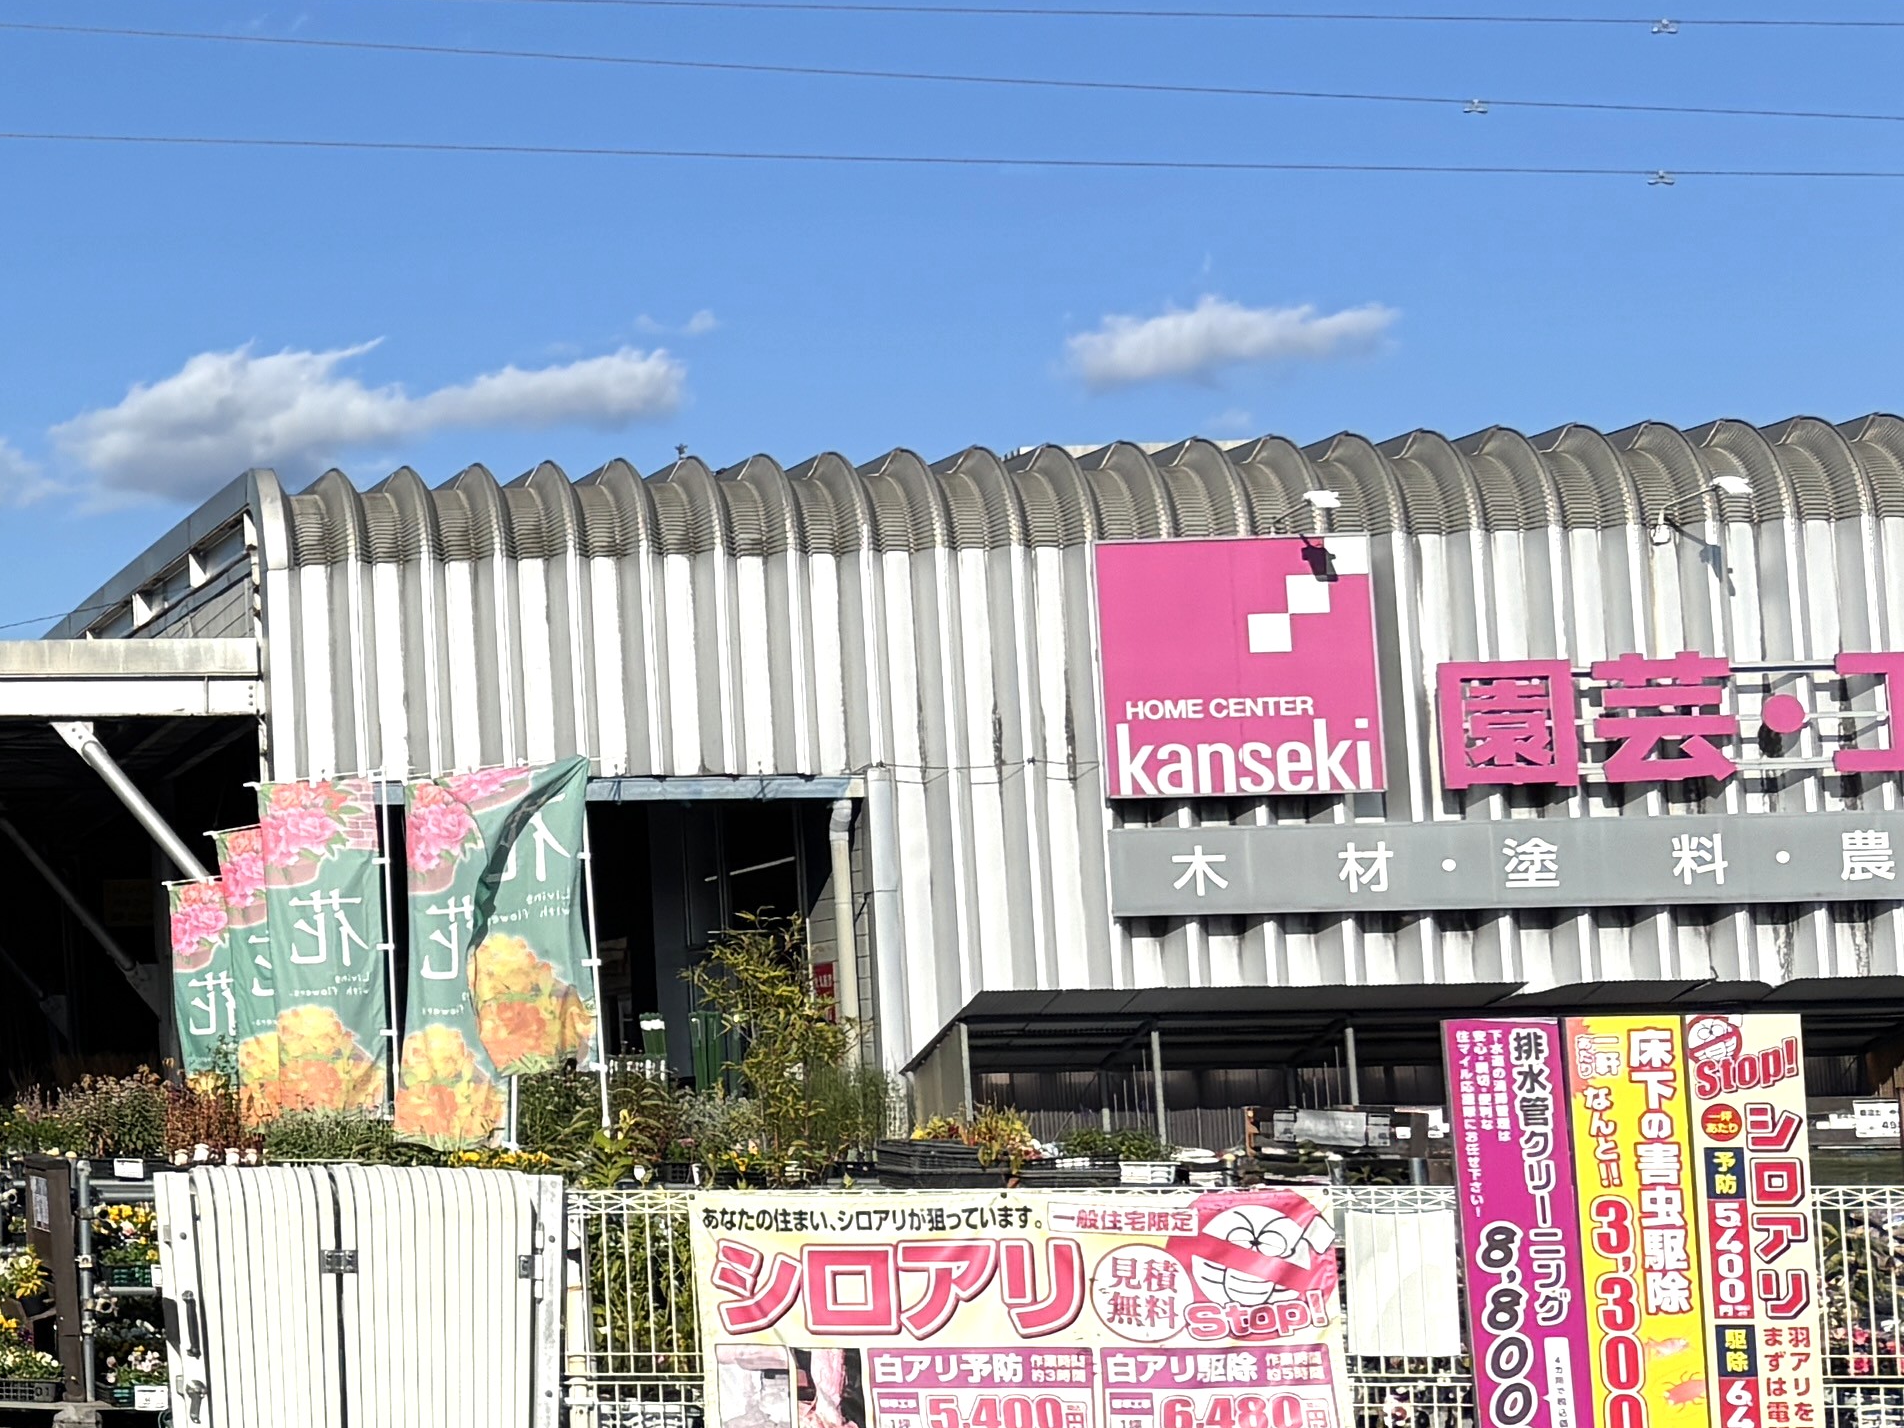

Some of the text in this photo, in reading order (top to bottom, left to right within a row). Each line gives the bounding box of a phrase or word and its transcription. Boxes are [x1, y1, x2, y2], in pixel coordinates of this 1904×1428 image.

[1126, 696, 1314, 720] HOME CENTER
[1116, 718, 1373, 796] kanseki
[1171, 830, 1896, 897] 木材・塗料・農
[1694, 1036, 1800, 1100] Stop!
[1509, 1028, 1571, 1326] 排水管クリーニング
[1627, 1026, 1694, 1315] 床下の害虫駆除
[1712, 1151, 1738, 1195] 予防
[702, 1205, 1043, 1232] あなたの住まい、シロアリが狙っています。
[1053, 1209, 1193, 1232] 一般住宅限定
[1744, 1102, 1811, 1321] シロアリ
[711, 1237, 1086, 1341] シロアリ
[1109, 1256, 1179, 1293] 見積
[1107, 1291, 1179, 1329] 無料
[1184, 1289, 1330, 1341] Stop!
[873, 1353, 1024, 1383] 白アリ予防
[1106, 1351, 1257, 1383] 白アリ駆除
[1725, 1329, 1750, 1372] 駆除
